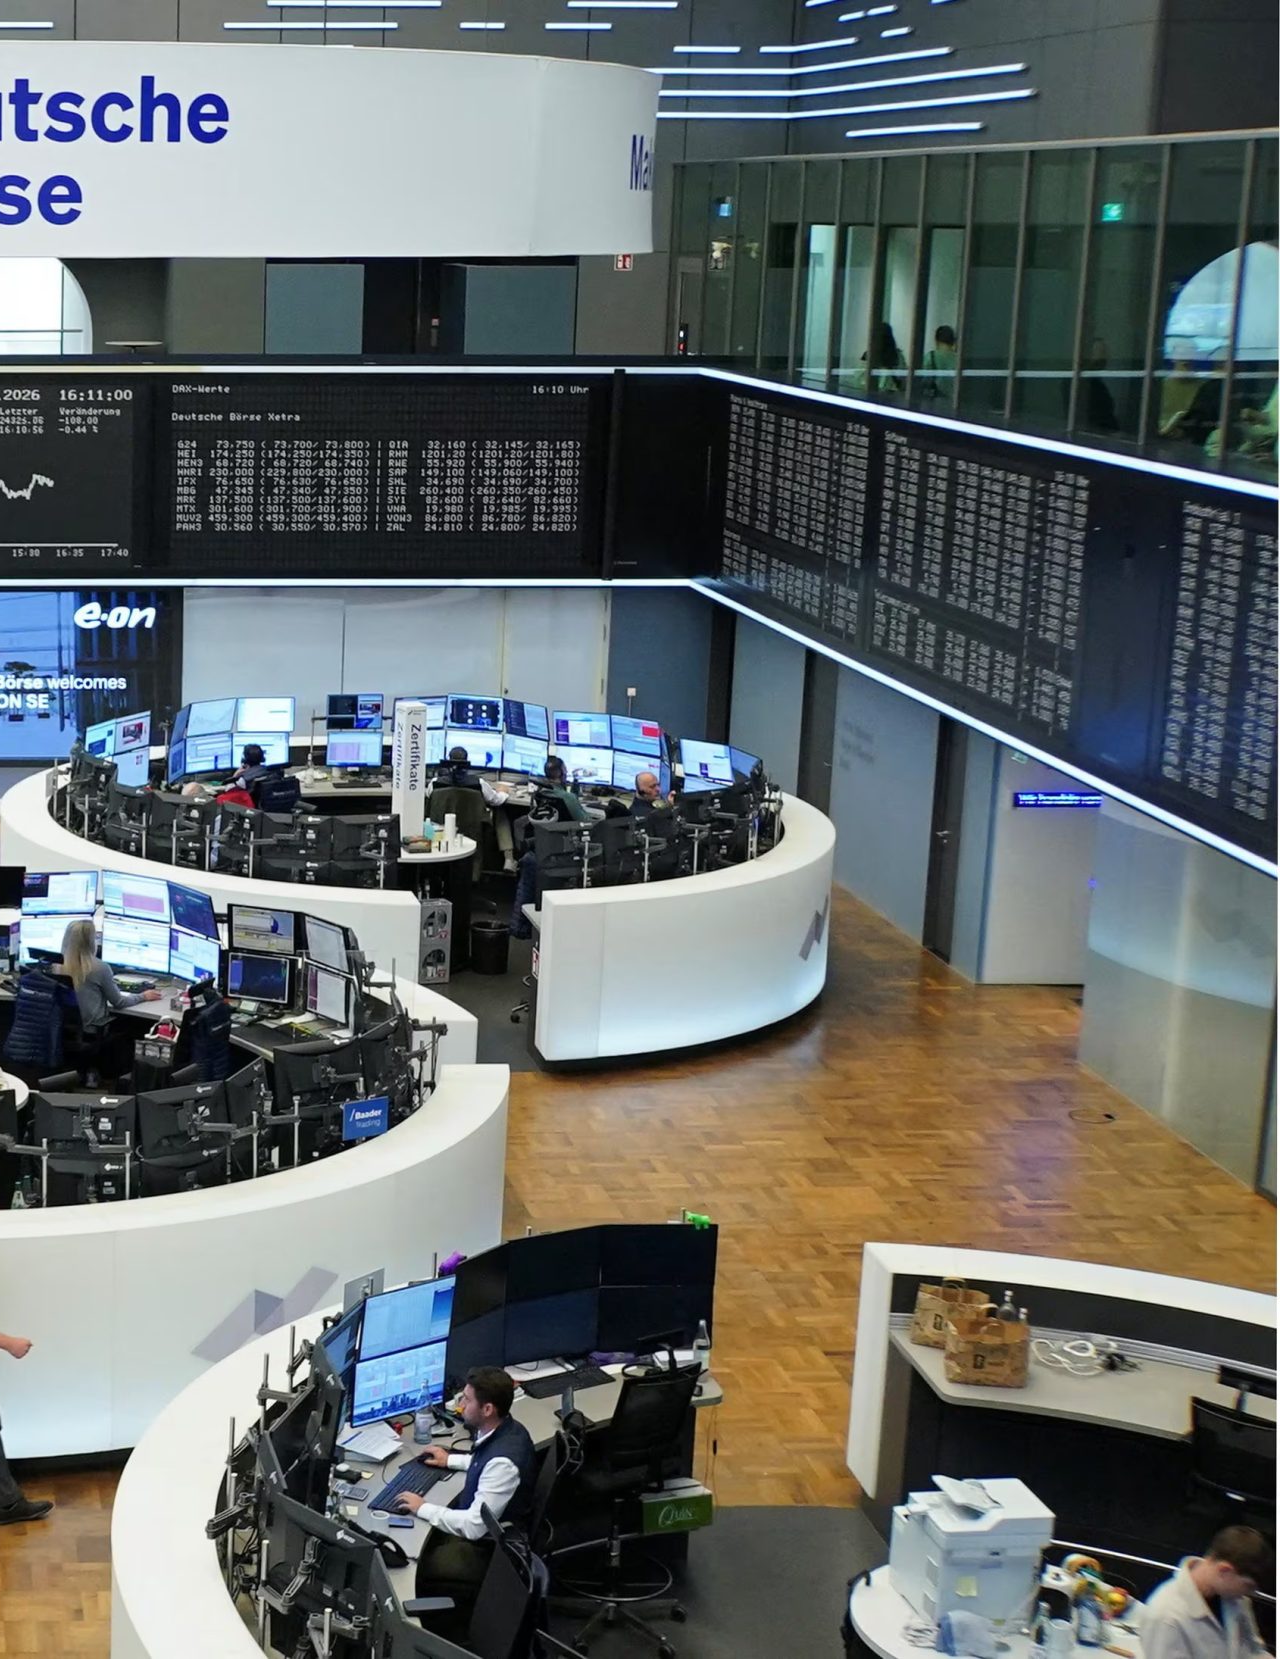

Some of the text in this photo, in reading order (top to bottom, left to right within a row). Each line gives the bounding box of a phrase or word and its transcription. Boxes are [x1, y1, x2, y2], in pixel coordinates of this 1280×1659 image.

[60, 390, 132, 401] 16:11:00
[47, 675, 127, 690] welcomes
[26, 693, 49, 709] SE
[409, 724, 421, 791] Zertifikate
